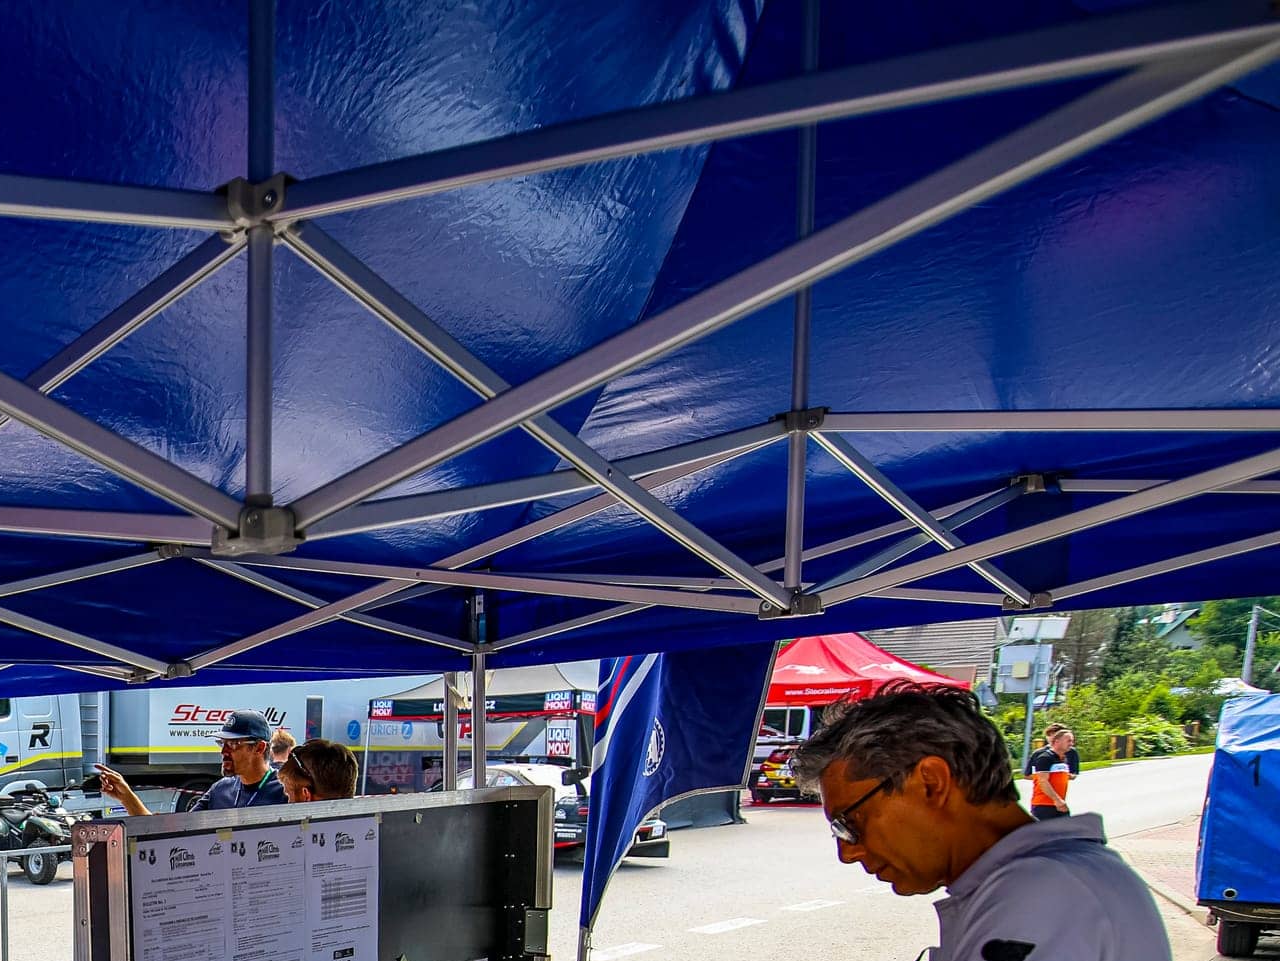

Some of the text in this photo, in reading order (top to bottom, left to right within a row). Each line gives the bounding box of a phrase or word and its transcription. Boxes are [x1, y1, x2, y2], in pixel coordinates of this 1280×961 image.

[547, 692, 570, 701] LIQUI
[373, 700, 393, 708] LIQUI
[545, 701, 570, 710] MOLY
[170, 704, 287, 726] Steclly
[372, 708, 393, 717] MOLY
[28, 723, 51, 748] R
[548, 728, 570, 741] LIQUI
[548, 741, 570, 755] MOLY
